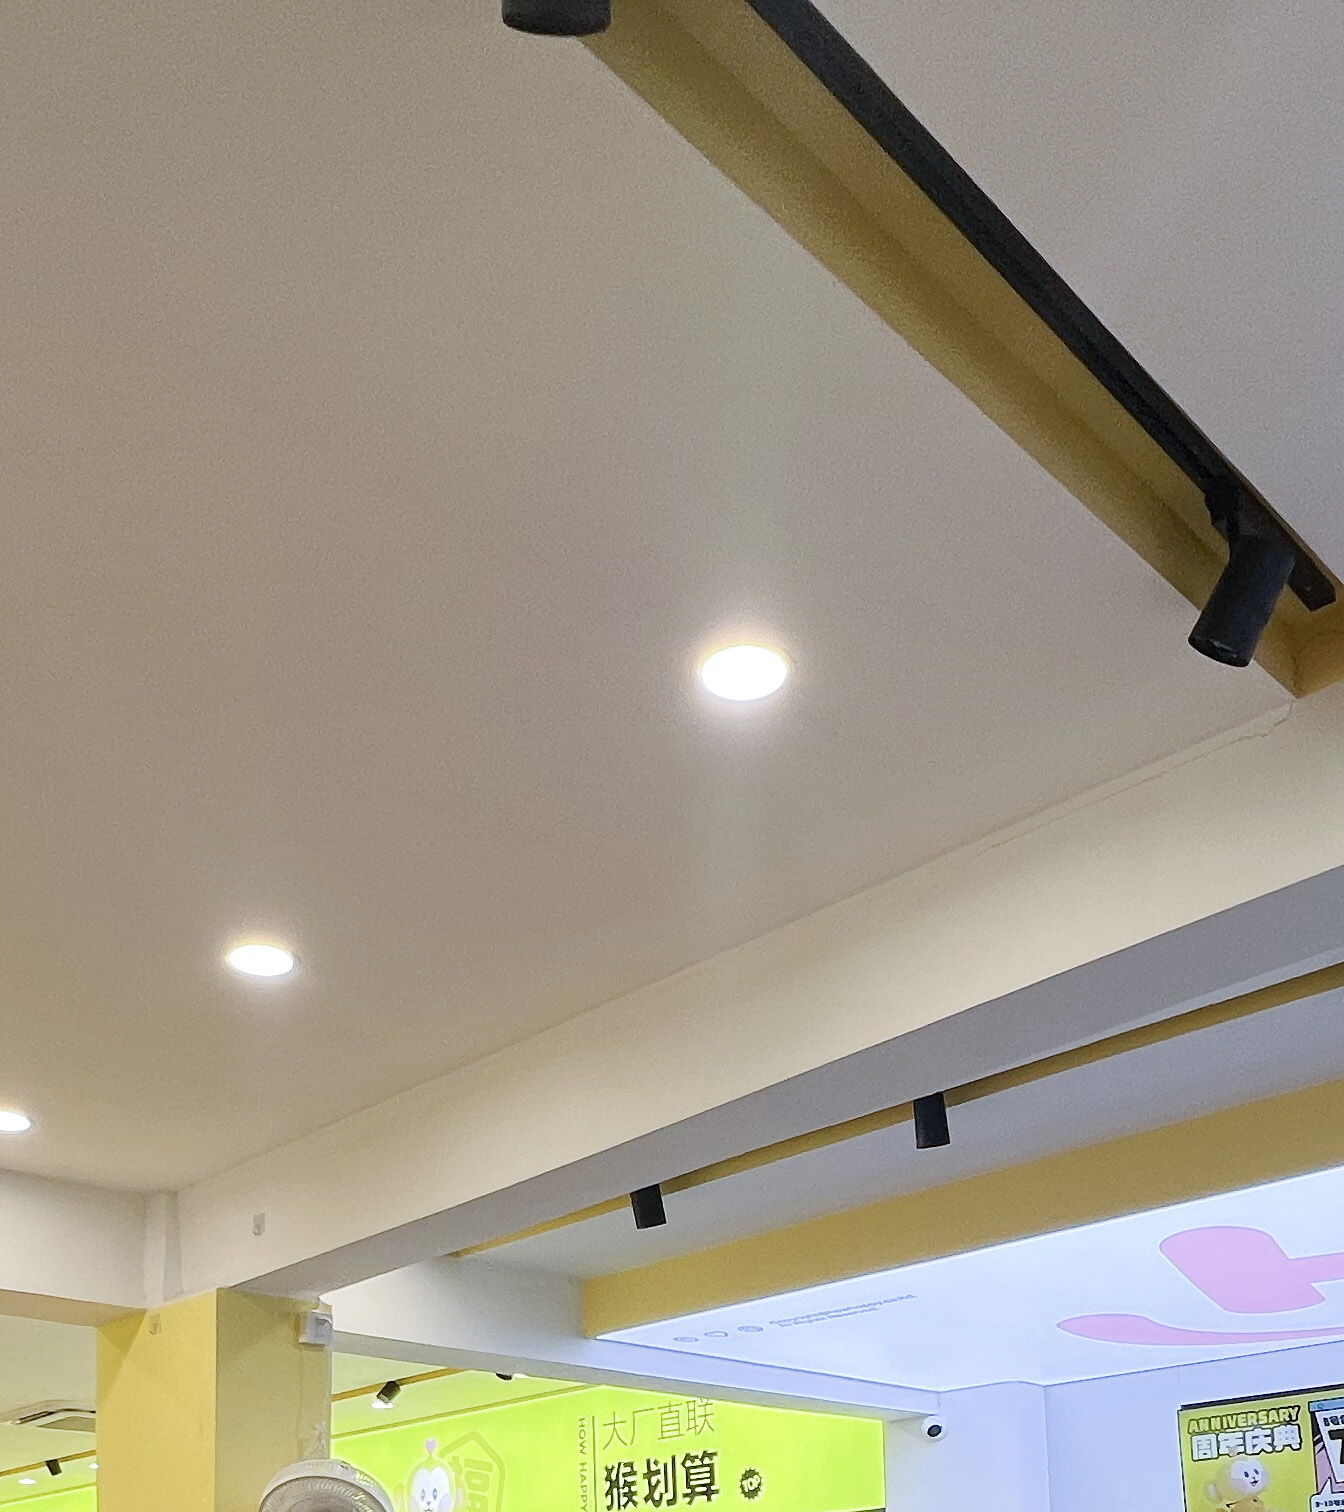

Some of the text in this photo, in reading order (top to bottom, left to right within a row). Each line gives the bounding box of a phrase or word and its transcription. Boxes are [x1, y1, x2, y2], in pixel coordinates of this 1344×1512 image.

[603, 1397, 715, 1450] 大厂直联
[1187, 1405, 1301, 1434] ANNIVERSARY
[1191, 1424, 1302, 1462] 周年庆典
[579, 1417, 589, 1512] HOW HAPPY
[605, 1450, 719, 1511] 猴划算
